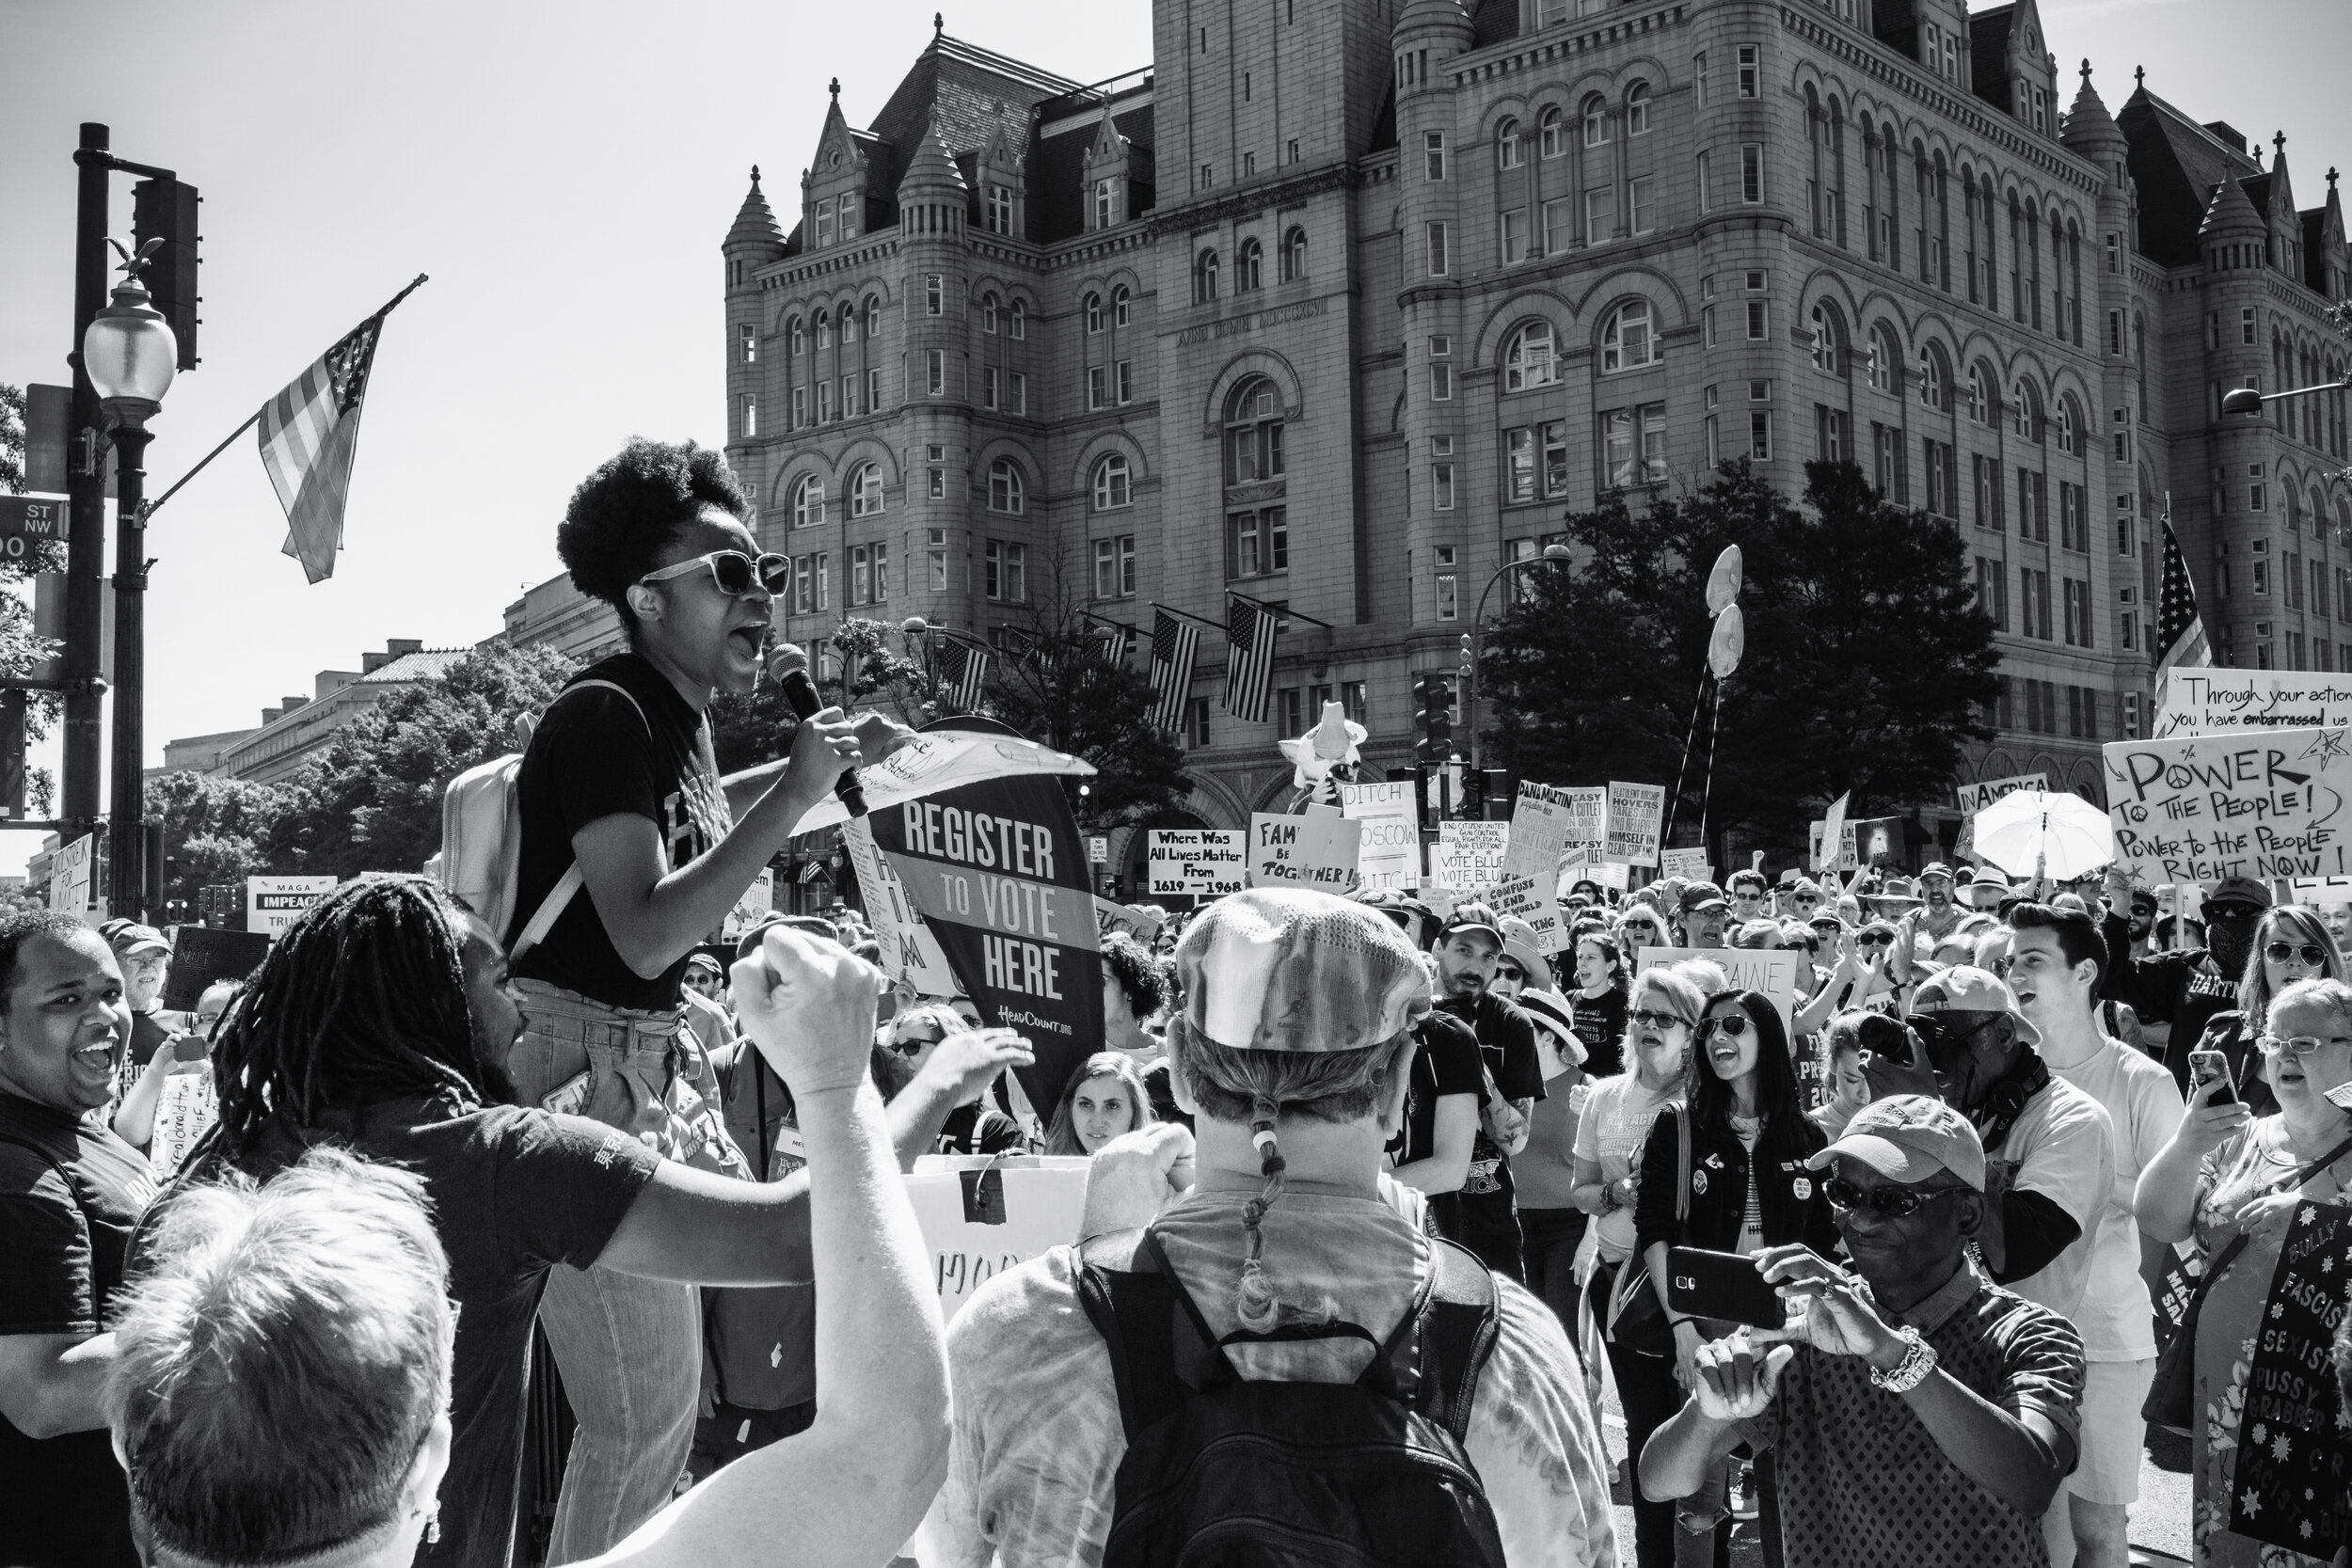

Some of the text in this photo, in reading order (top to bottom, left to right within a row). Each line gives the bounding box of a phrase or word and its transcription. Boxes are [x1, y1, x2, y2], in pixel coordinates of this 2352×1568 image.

[26, 504, 51, 518] ST
[24, 519, 52, 533] NW
[0, 537, 24, 557] 0
[2264, 689, 2305, 712] your
[2167, 707, 2348, 736] you have embarrassed us
[1343, 784, 1402, 805] DITCH
[1961, 792, 1976, 812] IN
[1577, 802, 1601, 816] CUTLET
[1613, 798, 1659, 809] HOVERS
[2156, 794, 2201, 820] THE
[1613, 806, 1657, 819] TAKES AIM
[1579, 817, 1601, 827] ONLY
[1611, 816, 1656, 833] AND RELIEVES
[904, 800, 1055, 879] REGISTER
[1158, 832, 1230, 844] Where Was
[1260, 823, 1300, 847] FAM
[1360, 824, 1418, 847] OSCOW
[1609, 831, 1656, 846] HIMSELF IN
[1563, 841, 1603, 849] REASY
[1607, 842, 1654, 858] CLEAR STREAMS
[1150, 847, 1242, 862] All Lives Matter
[1441, 856, 1471, 867] VOTE
[1184, 863, 1214, 878] From
[1262, 862, 1354, 886] TOGTHER!
[1442, 870, 1471, 882] VOTE
[1476, 870, 1500, 882] BLU
[755, 876, 769, 886] em
[1154, 880, 1184, 892] 1619
[1207, 881, 1242, 893] 1968
[1362, 871, 1418, 889] ITCH
[1489, 879, 1535, 899] CONFUSE
[941, 872, 970, 916] TO
[978, 873, 1058, 940] VOTE
[1503, 894, 1526, 908] END
[1511, 900, 1543, 915] WORLD
[268, 916, 298, 927] TRU
[1530, 917, 1555, 930] ING
[983, 934, 1062, 1000] HERE
[1585, 1034, 1600, 1042] STED
[1998, 1117, 2010, 1131] EO
[1461, 1174, 1502, 1194] ICA
[2288, 1220, 2339, 1265] BULLY
[1971, 1241, 1983, 1262] FUCK
[2280, 1271, 2343, 1329] FASCIS
[2257, 1368, 2318, 1408] PUSSY
[2249, 1394, 2326, 1434] GRABBER
[2242, 1445, 2302, 1523] RACIST
